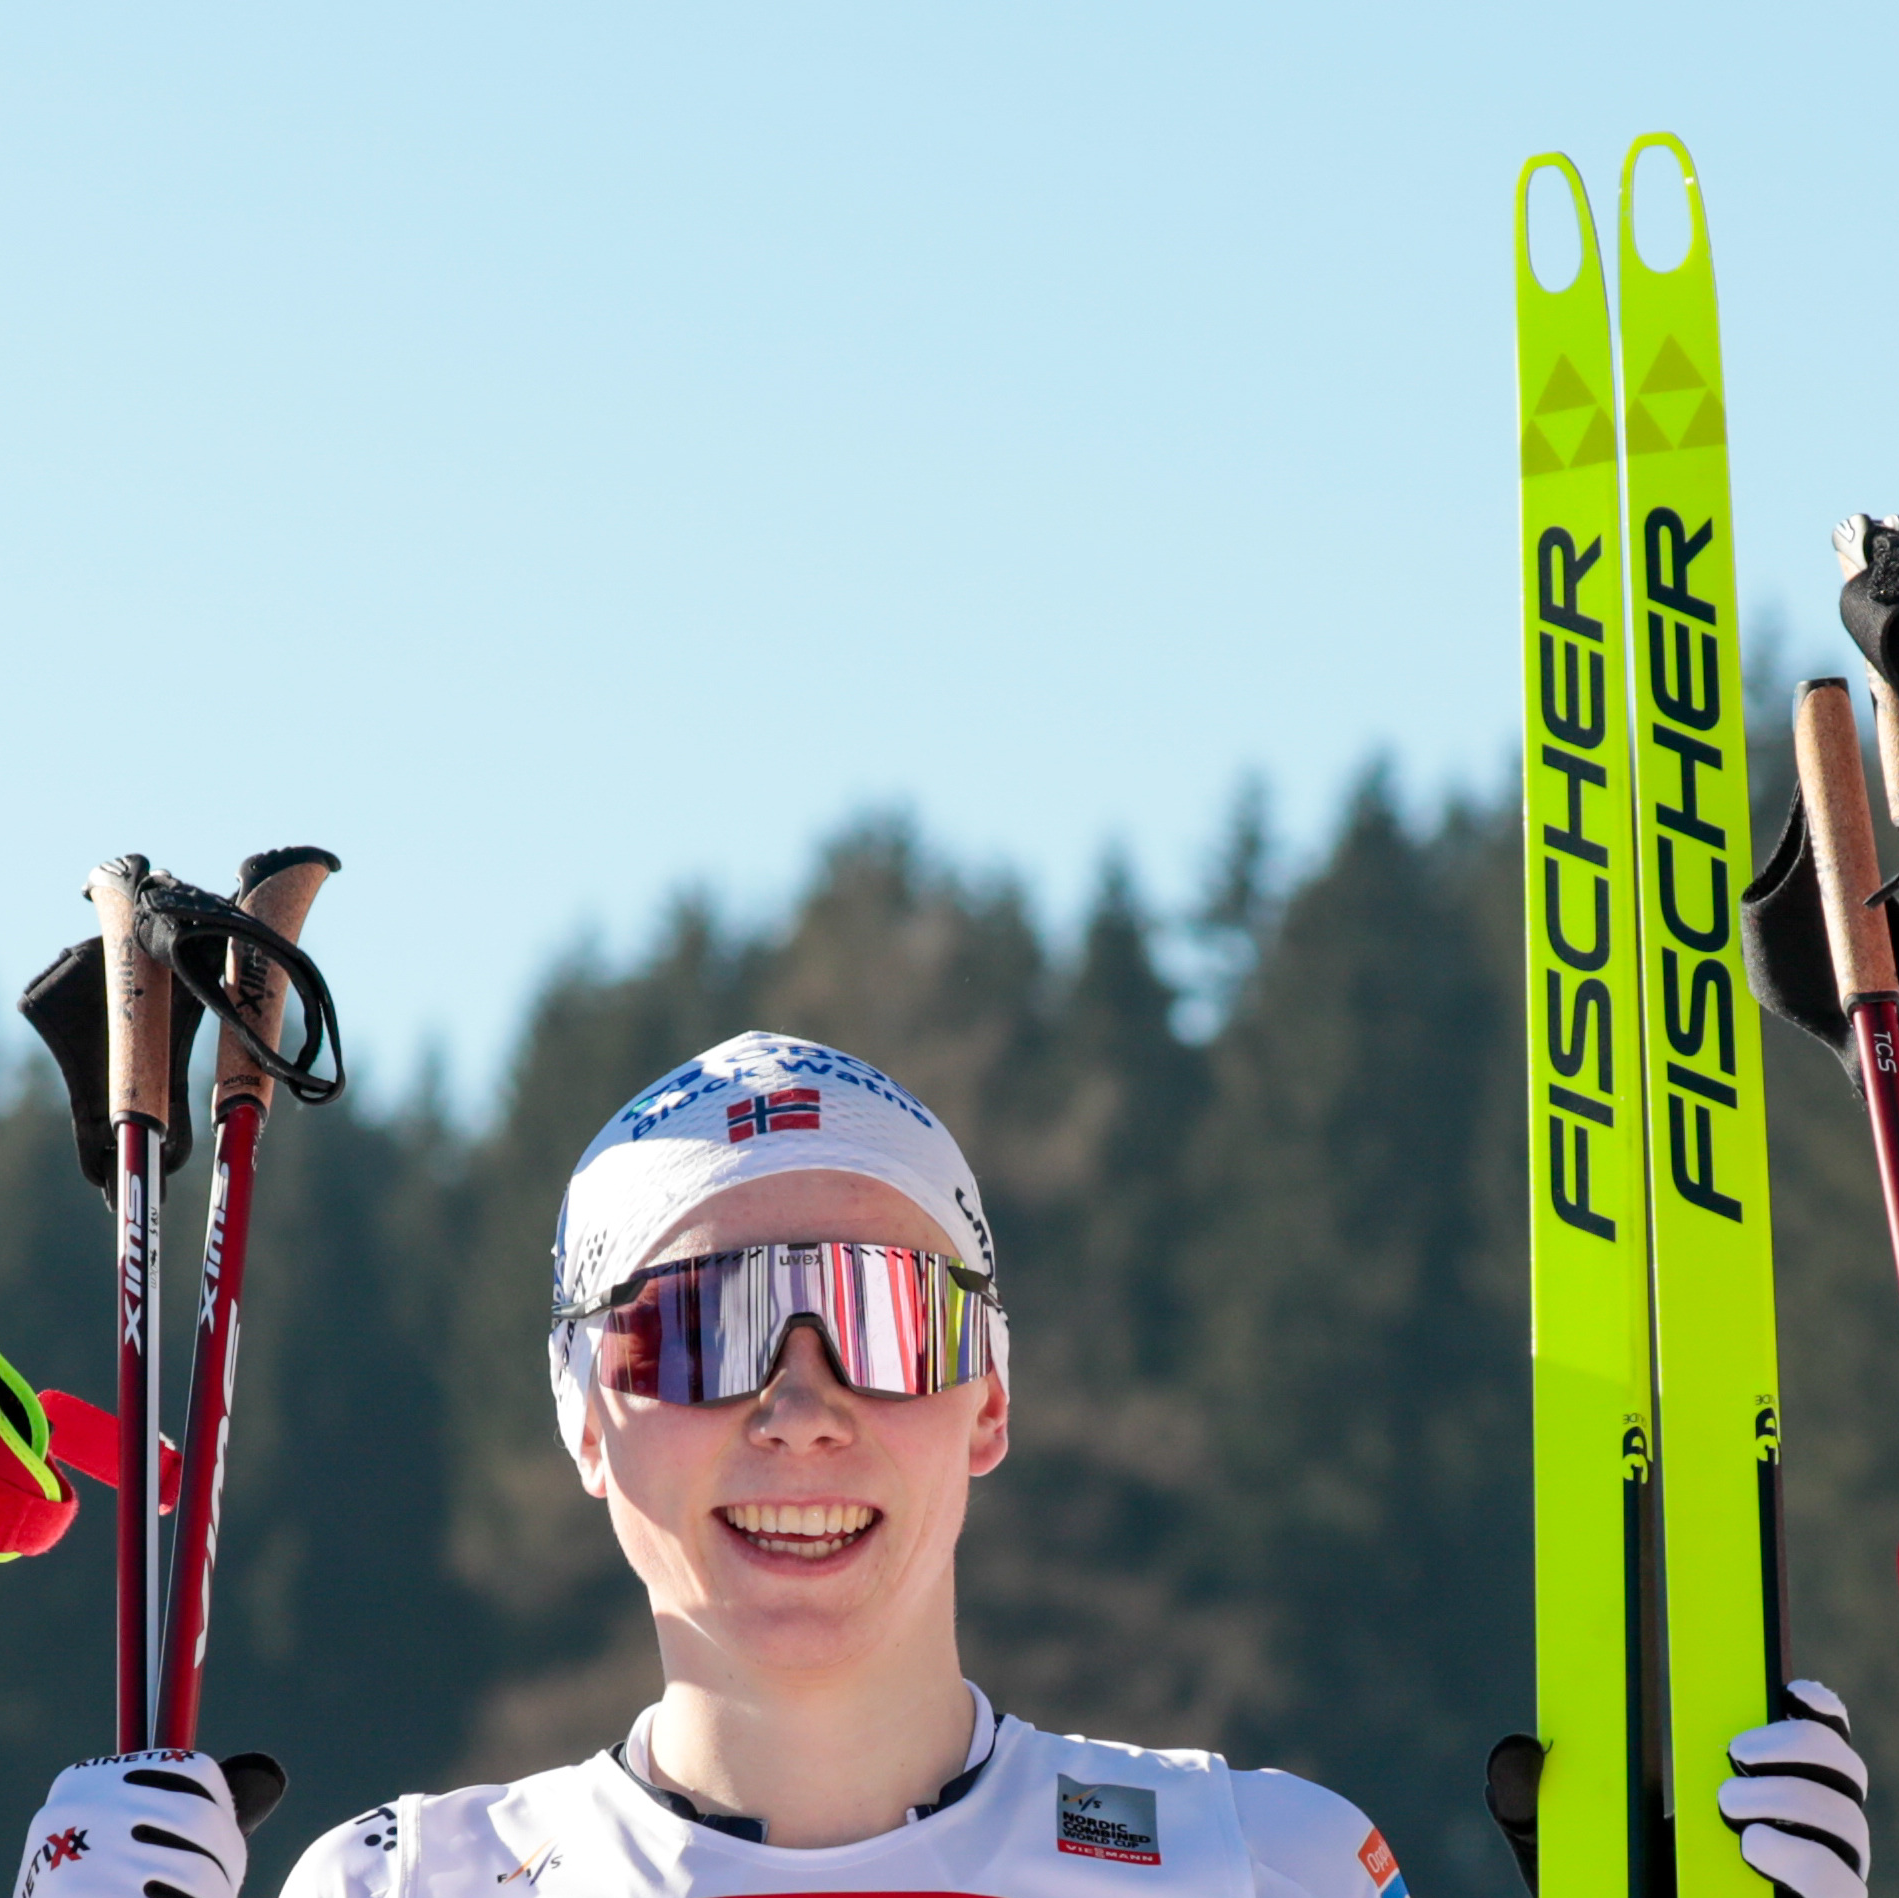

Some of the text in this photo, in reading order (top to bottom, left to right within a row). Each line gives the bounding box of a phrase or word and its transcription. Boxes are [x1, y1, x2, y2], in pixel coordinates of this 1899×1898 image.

[1537, 525, 1616, 1243] FISCHER
[1644, 506, 1743, 1224] FISCHER
[777, 1059, 933, 1128] Watne
[123, 1170, 142, 1355] SWIX
[779, 1252, 824, 1266] uvex
[1063, 1811, 1127, 1833] NORDIC
[1063, 1820, 1151, 1844] COMBINED
[1063, 1828, 1139, 1849] WORLD CUP
